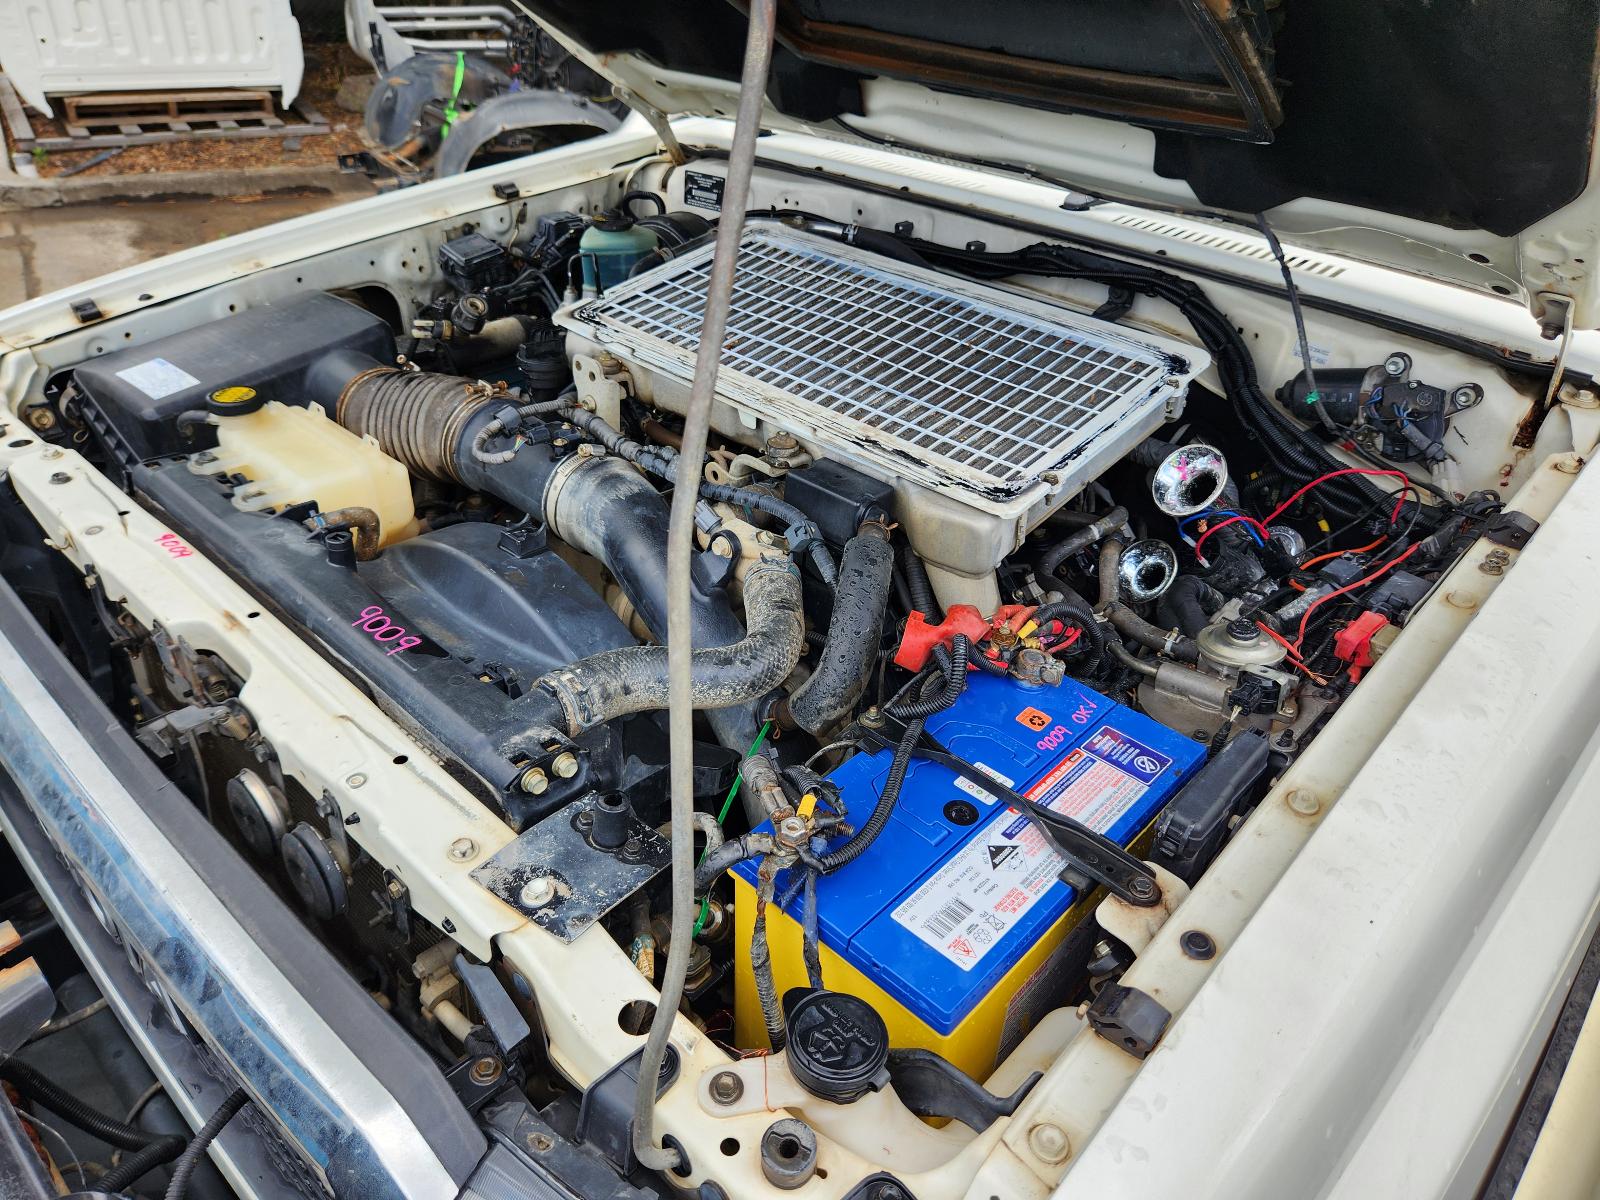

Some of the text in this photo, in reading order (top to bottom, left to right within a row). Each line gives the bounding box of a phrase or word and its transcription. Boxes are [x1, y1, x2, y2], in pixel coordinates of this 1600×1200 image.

[153, 533, 193, 559] 9009
[351, 605, 423, 657] 9009
[1037, 725, 1073, 751] 9009
[982, 882, 999, 896] Century
